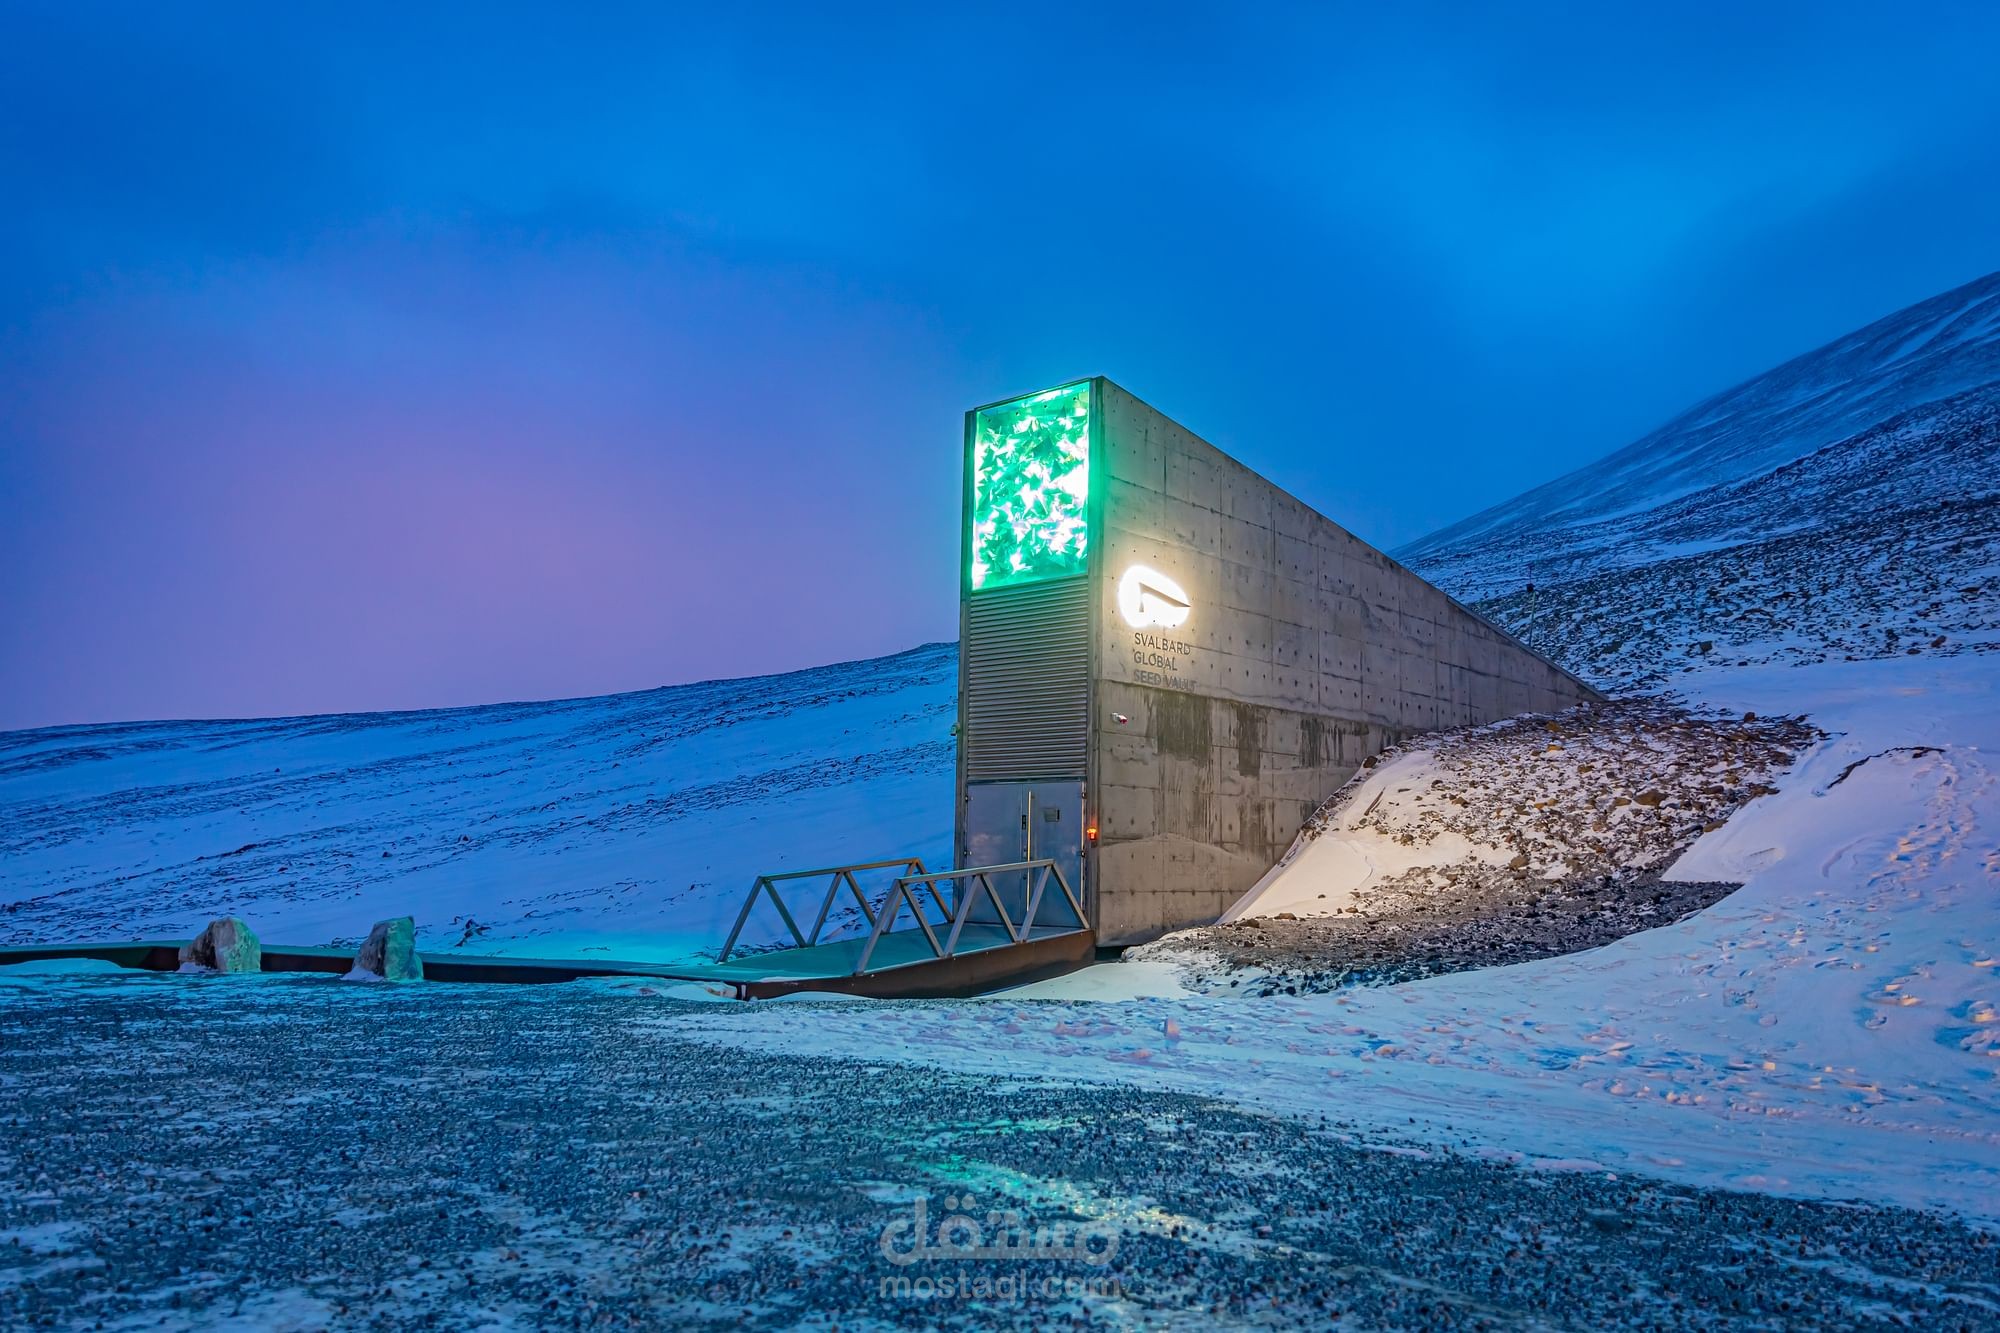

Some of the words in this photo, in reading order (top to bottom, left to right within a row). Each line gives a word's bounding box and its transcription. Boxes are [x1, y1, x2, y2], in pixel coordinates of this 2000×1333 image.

[1134, 632, 1191, 655] SVALBARD
[1133, 651, 1178, 671] GLOBAL
[1134, 669, 1161, 685] SEED
[1164, 675, 1196, 692] VAULT
